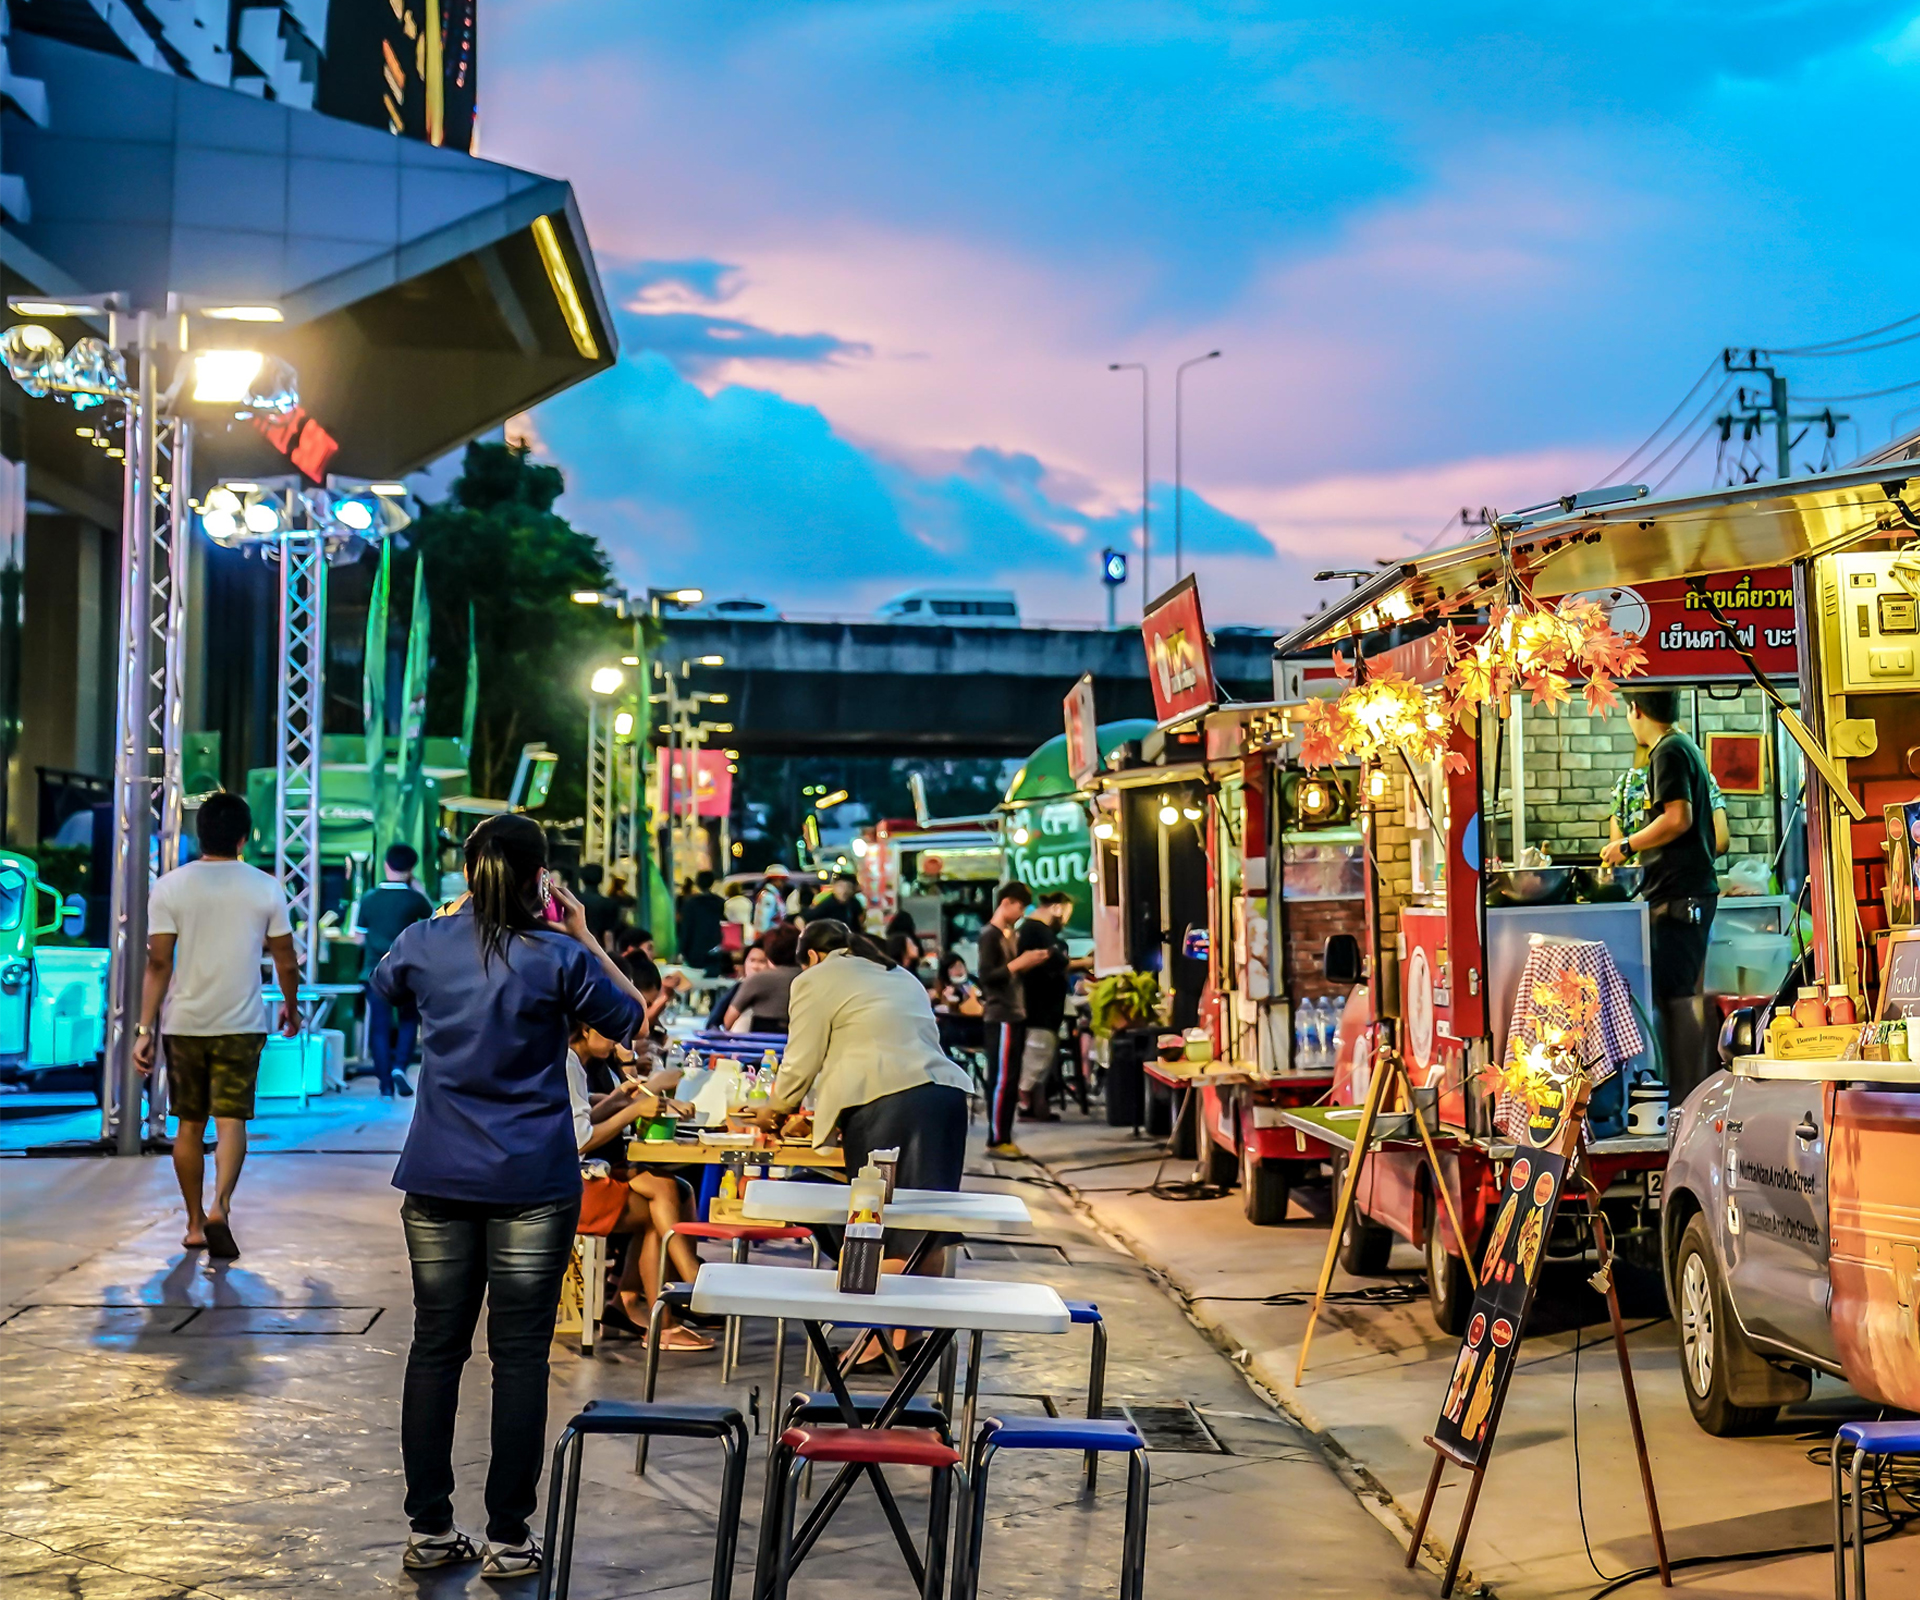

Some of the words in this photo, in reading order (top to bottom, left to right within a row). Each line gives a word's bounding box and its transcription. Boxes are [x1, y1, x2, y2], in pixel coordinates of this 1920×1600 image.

[1685, 576, 1793, 609] กยเตี๋ยวห
[1004, 847, 1092, 888] han
[1891, 955, 1918, 994] French
